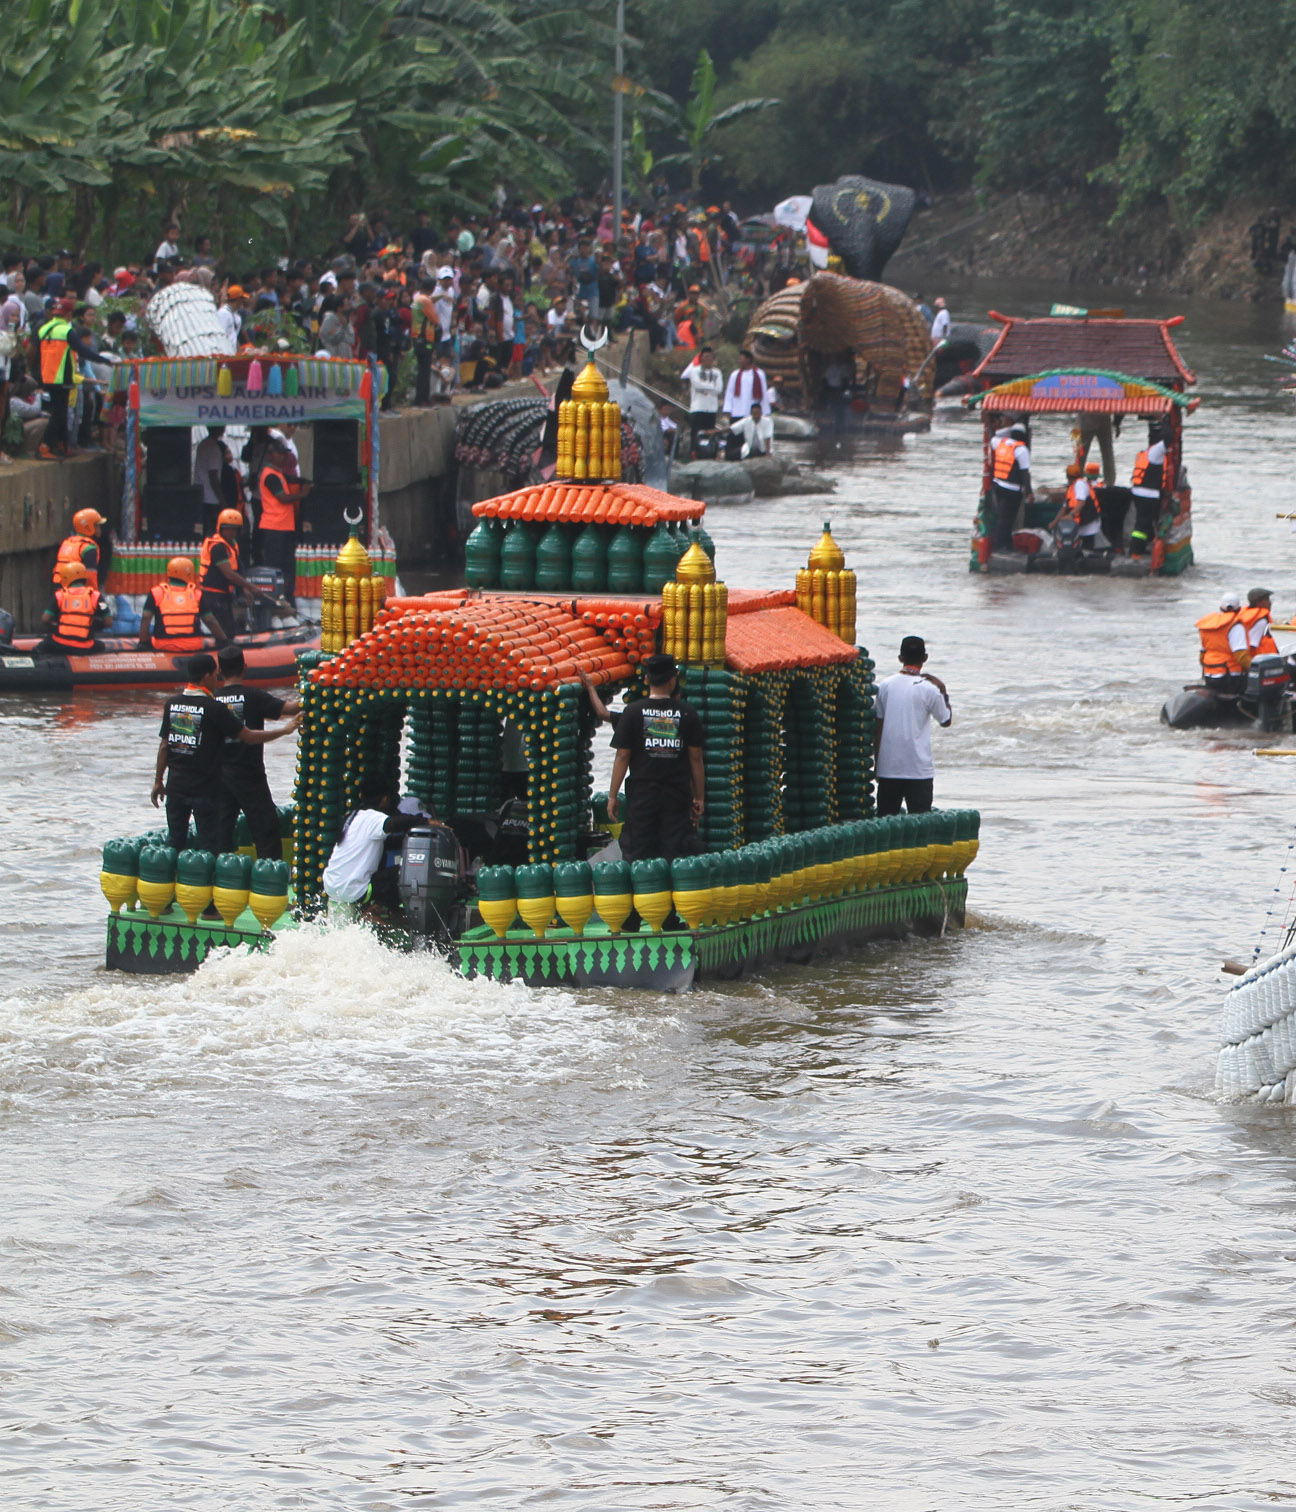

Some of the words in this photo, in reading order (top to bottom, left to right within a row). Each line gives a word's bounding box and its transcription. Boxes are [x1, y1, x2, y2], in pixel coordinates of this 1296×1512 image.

[175, 385, 214, 399] UPS
[198, 404, 305, 418] PALMERAH
[170, 703, 205, 715] MUSHOLA
[168, 733, 197, 746] APUNG
[645, 738, 681, 748] APUNG
[407, 853, 426, 861] 50
